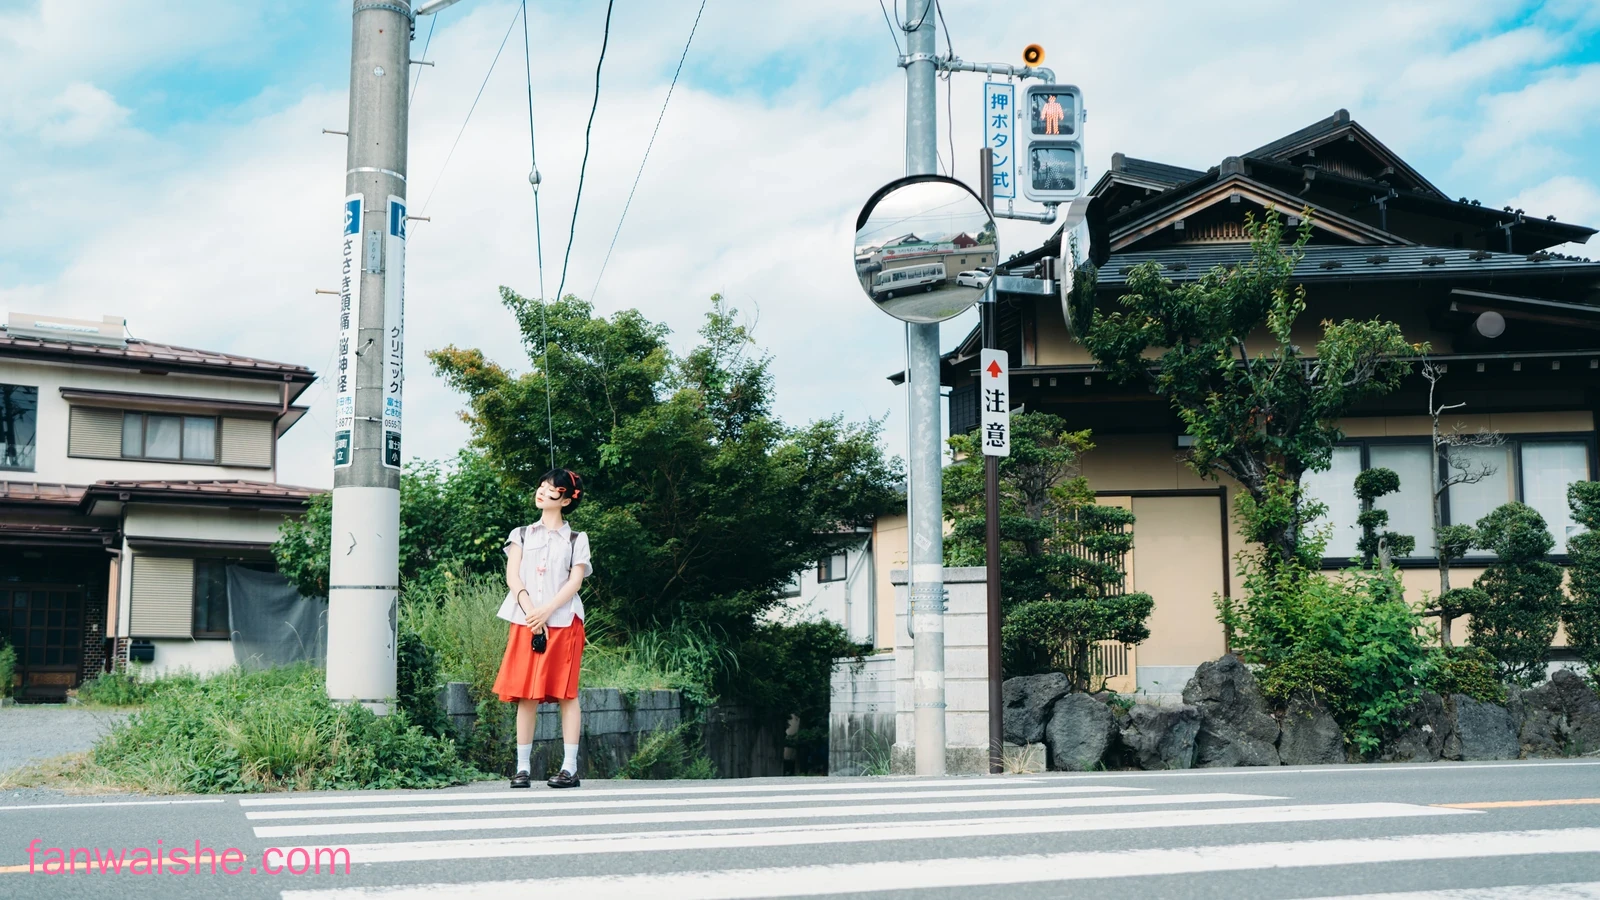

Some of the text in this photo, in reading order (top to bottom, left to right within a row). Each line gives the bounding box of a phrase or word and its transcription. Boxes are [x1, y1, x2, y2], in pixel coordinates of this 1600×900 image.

[991, 93, 1009, 188] 押ボタン式
[390, 326, 400, 393] クリニック
[985, 389, 1006, 447] 注意
